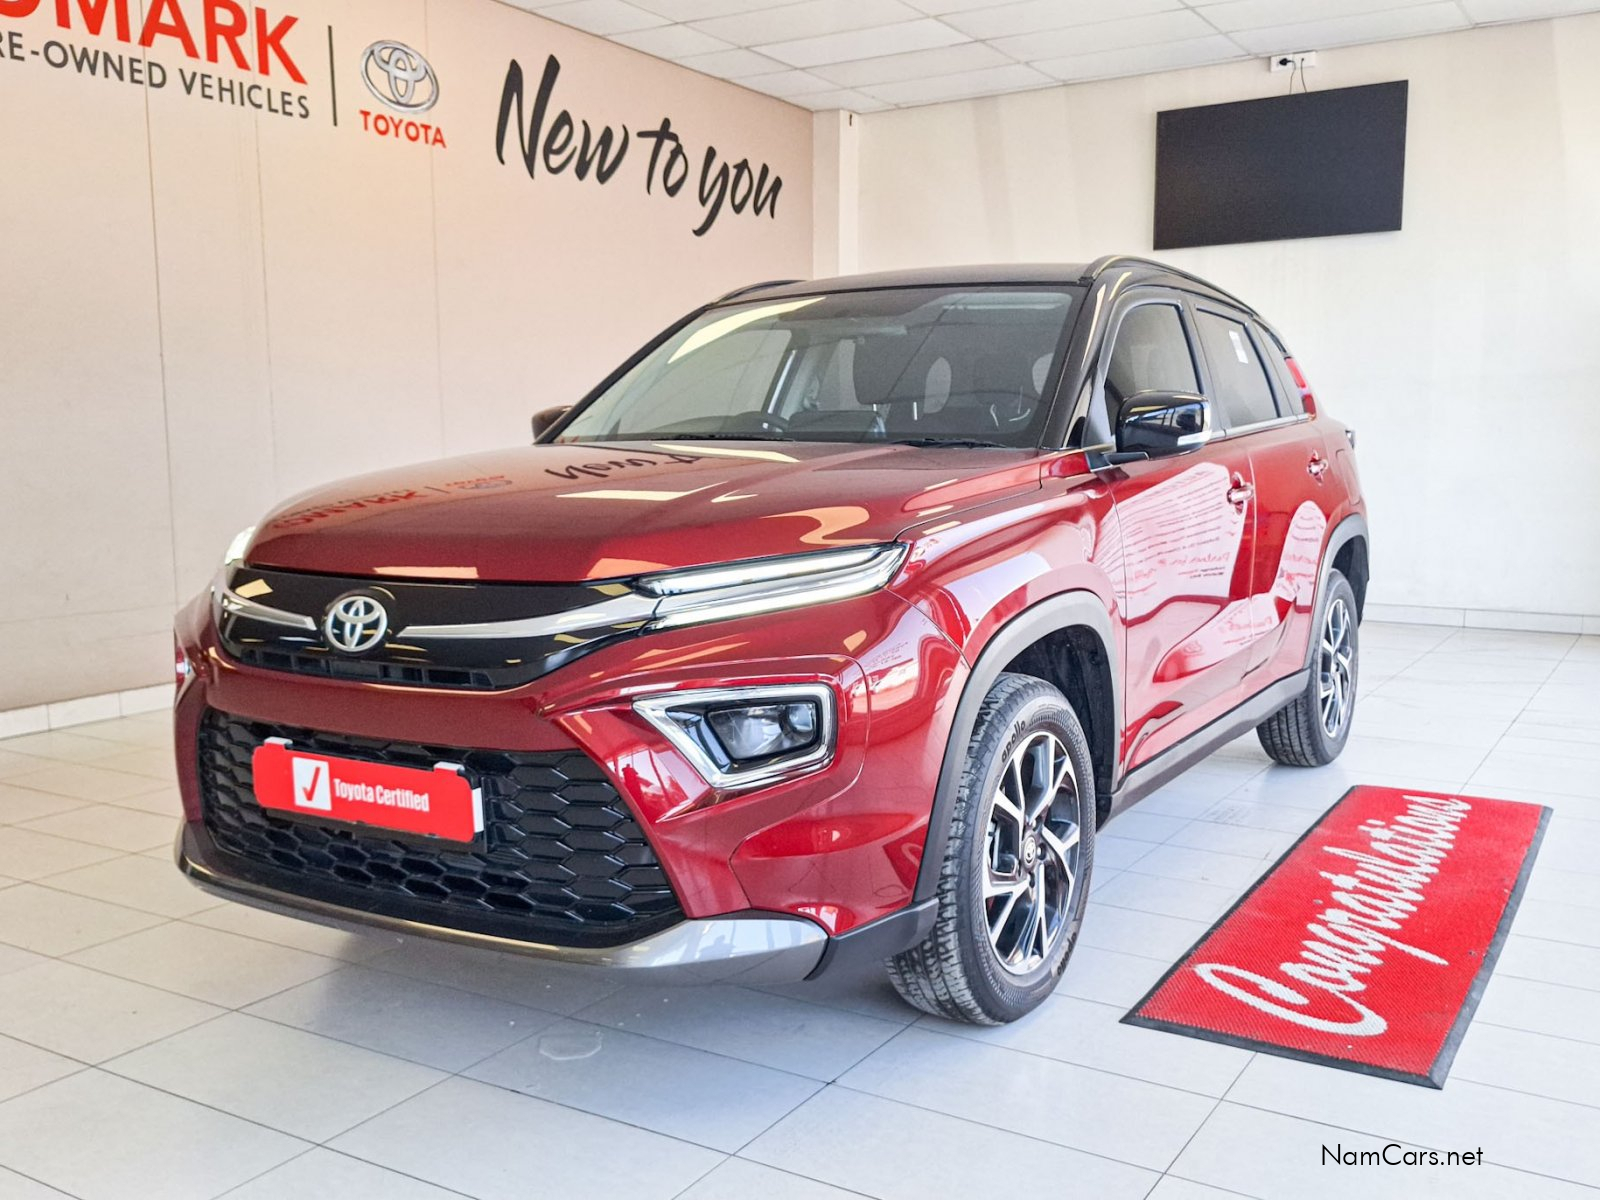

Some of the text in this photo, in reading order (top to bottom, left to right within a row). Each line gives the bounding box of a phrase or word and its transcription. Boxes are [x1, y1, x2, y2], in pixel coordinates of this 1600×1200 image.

[0, 0, 308, 86] MARK
[0, 31, 310, 119] E-OWNED VEHICLES
[360, 110, 446, 148] TOYOTA
[496, 54, 783, 237] New to you
[1001, 720, 1026, 763] apollo
[332, 778, 431, 813] Toyota Certified
[1195, 794, 1473, 1037] Congratulations
